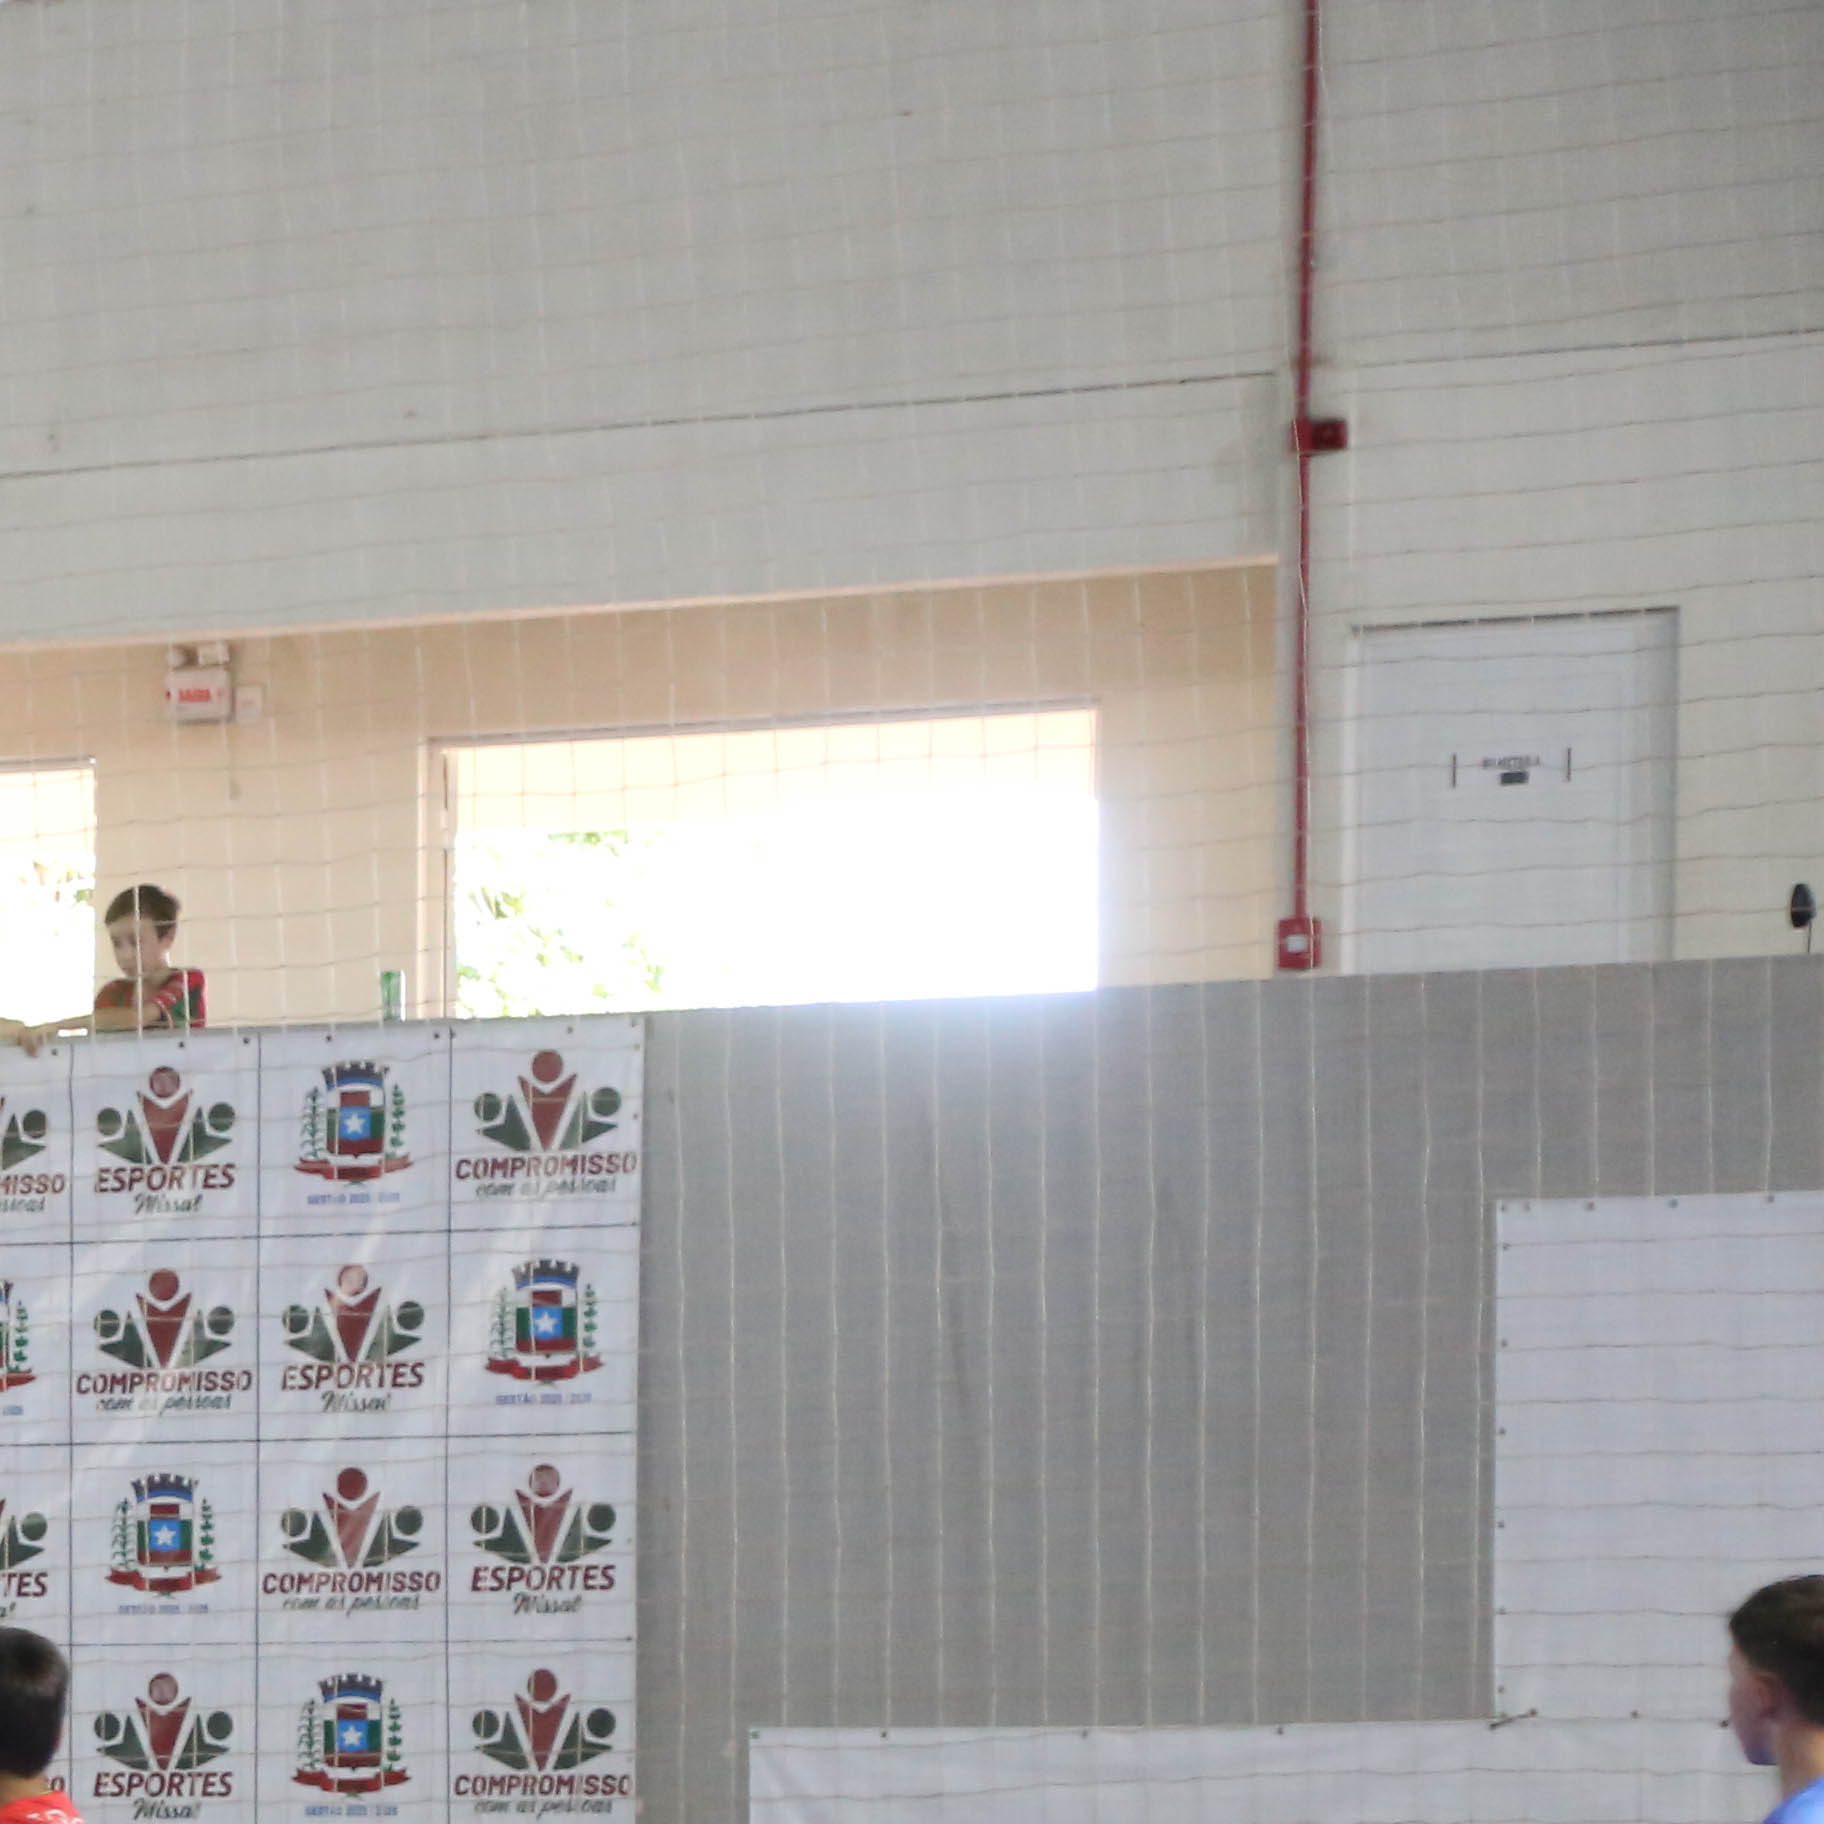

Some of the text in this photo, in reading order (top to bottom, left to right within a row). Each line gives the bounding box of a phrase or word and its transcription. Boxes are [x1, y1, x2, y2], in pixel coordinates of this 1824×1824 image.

[95, 1164, 235, 1194] ESPORTES
[456, 1152, 637, 1179] COMPROMISSO
[76, 1369, 253, 1395] COMPROMISSO
[281, 1363, 426, 1392] ESPORTES
[261, 1571, 441, 1596] COMPROMISSO
[471, 1565, 616, 1592] ESPORTES
[93, 1771, 233, 1798] ESPORTES
[455, 1773, 630, 1797] COMPROMISSO
